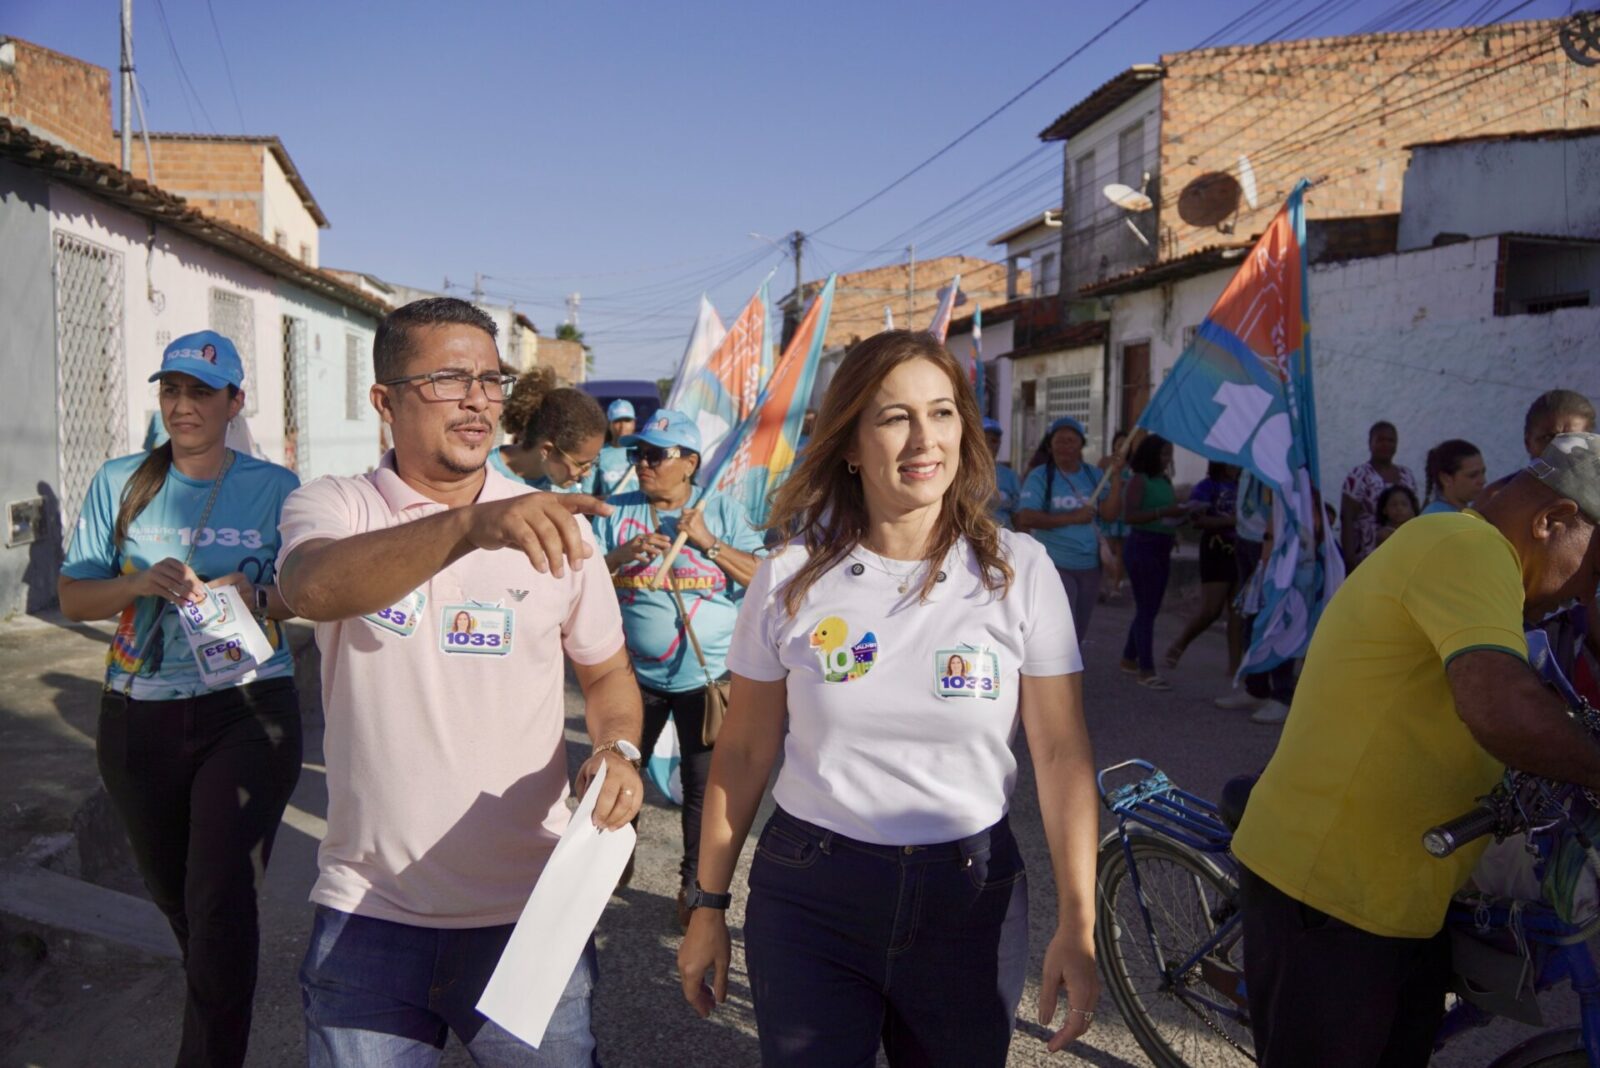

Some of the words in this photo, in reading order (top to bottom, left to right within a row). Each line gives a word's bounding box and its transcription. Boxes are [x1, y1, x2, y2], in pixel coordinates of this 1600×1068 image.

[178, 527, 263, 549] 1033
[446, 632, 501, 646] 1033
[941, 676, 993, 691] 1033
